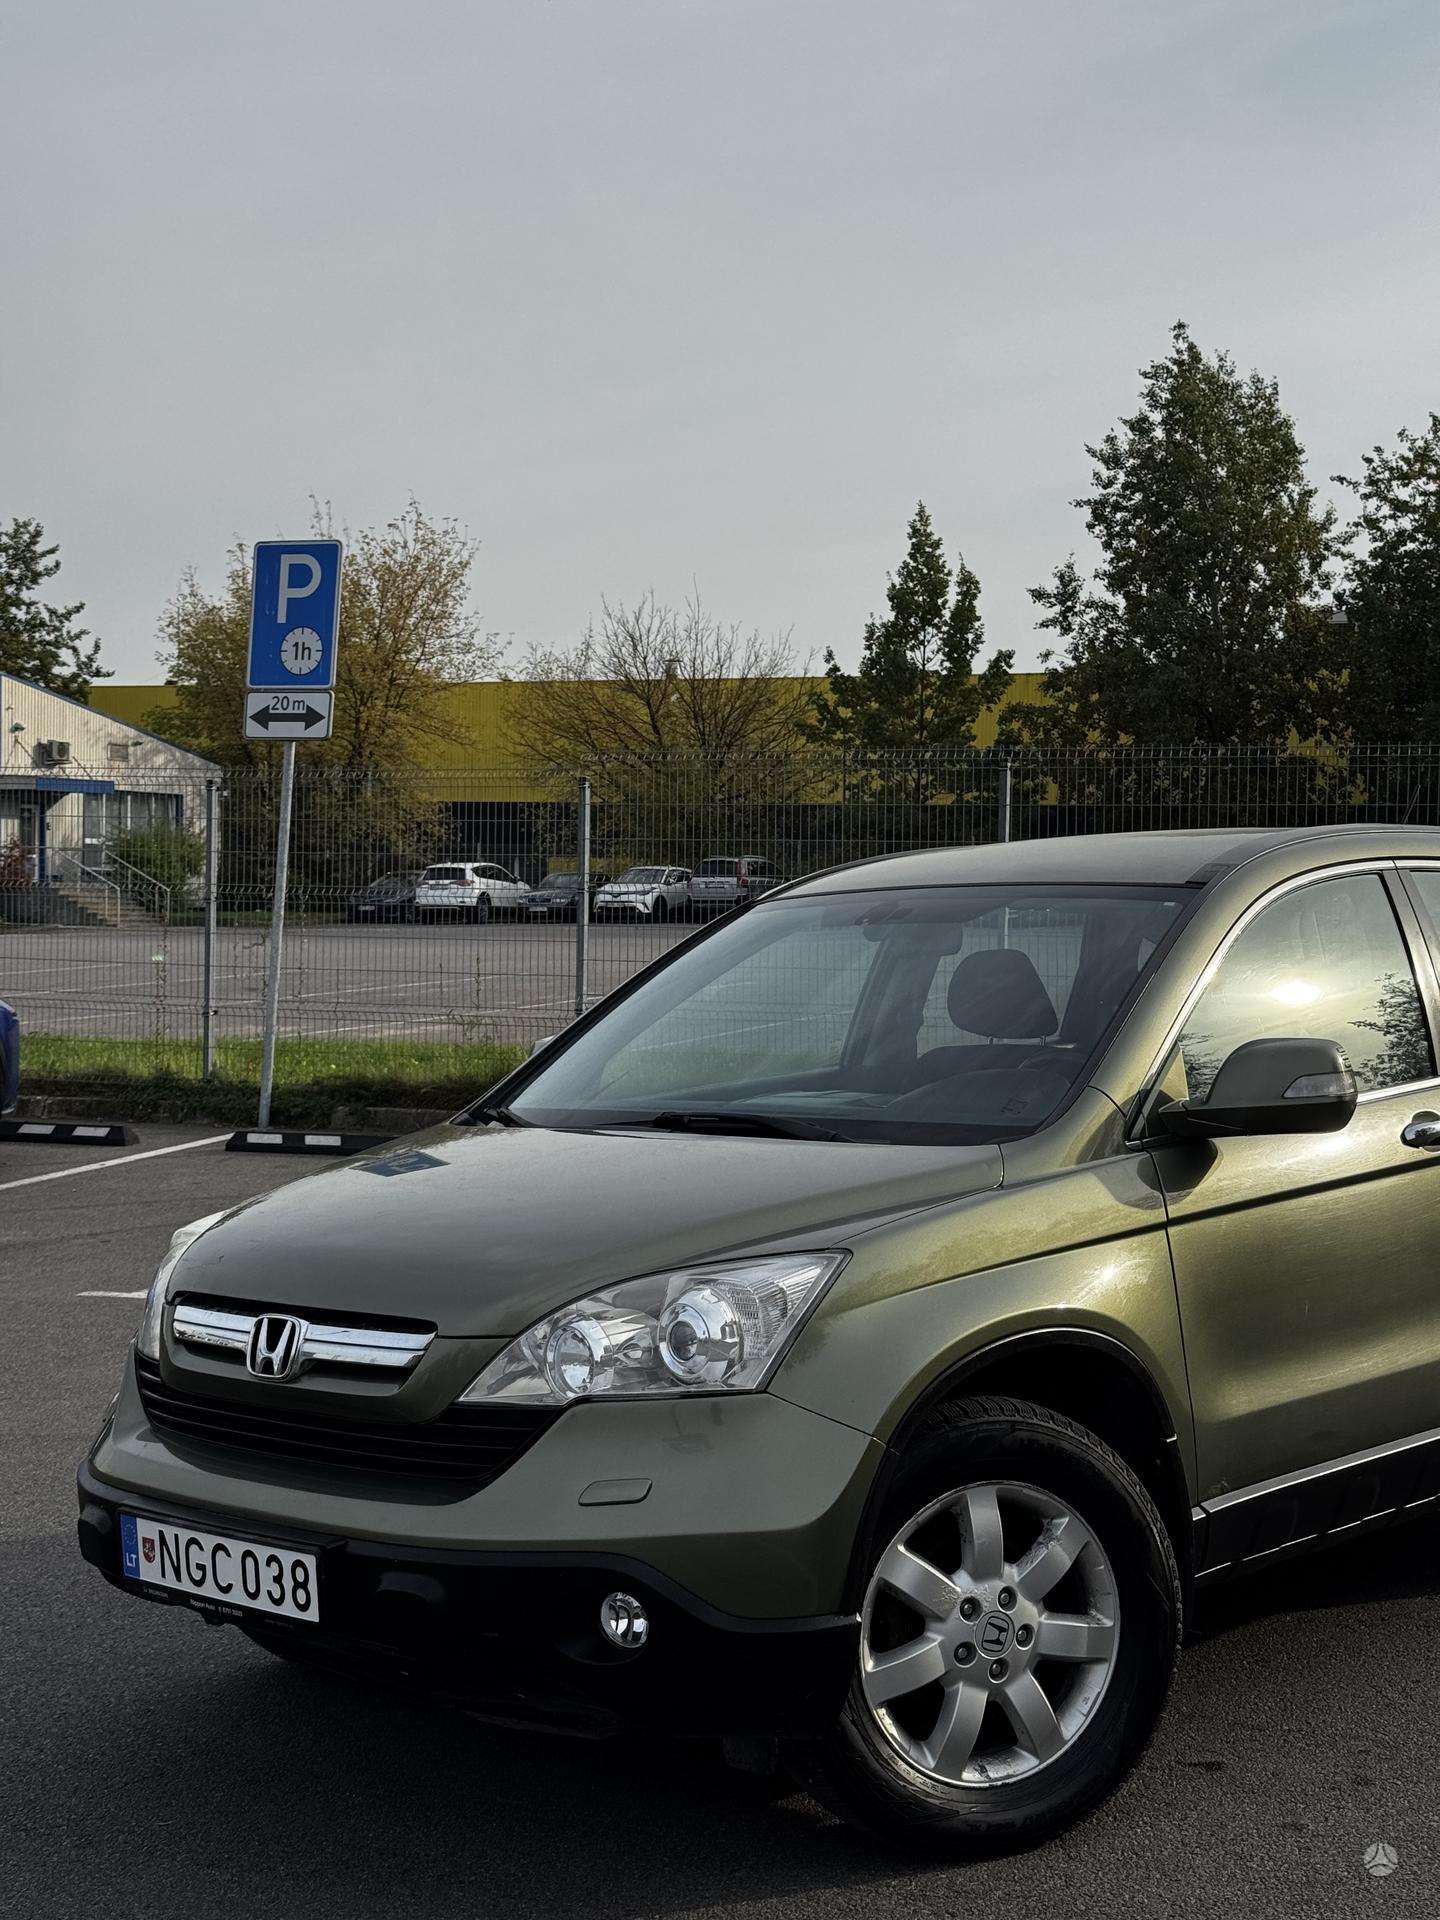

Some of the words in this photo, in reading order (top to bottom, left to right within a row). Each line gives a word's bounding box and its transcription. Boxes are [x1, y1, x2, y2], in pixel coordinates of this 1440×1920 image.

[277, 554, 321, 623] P
[292, 642, 311, 660] 1h
[271, 696, 289, 711] 20
